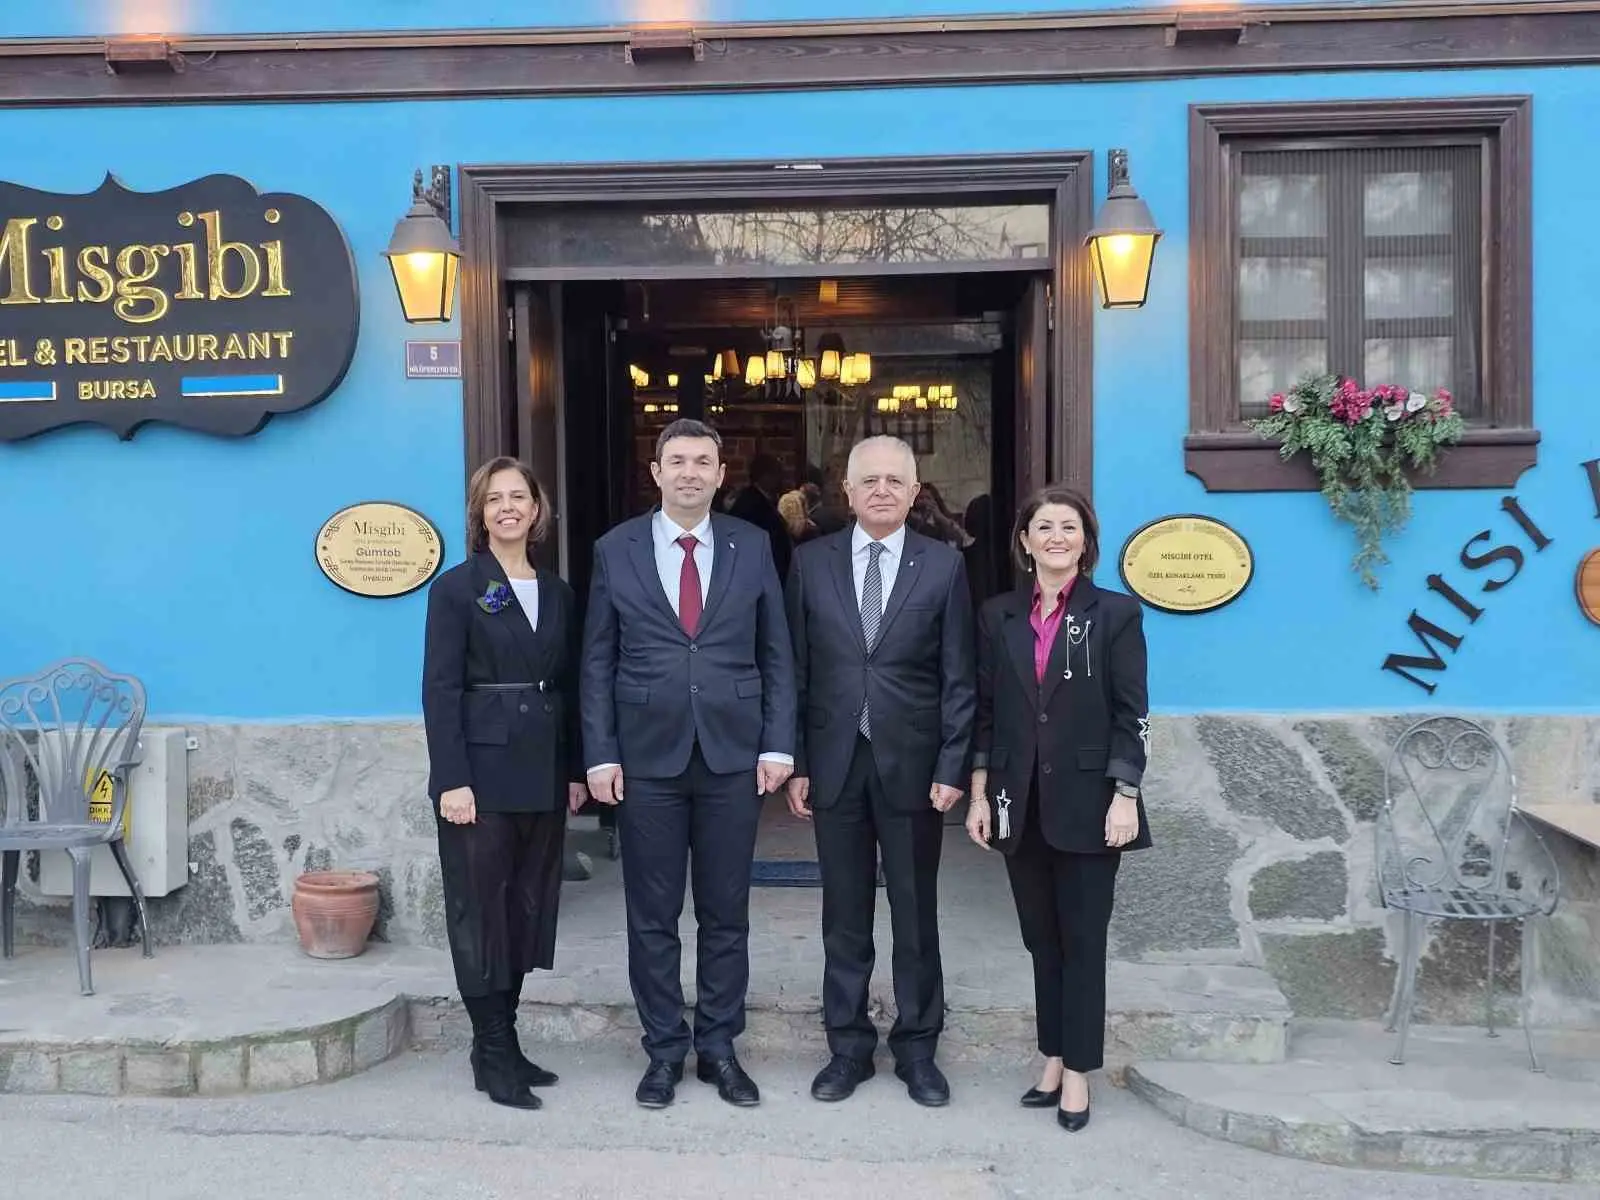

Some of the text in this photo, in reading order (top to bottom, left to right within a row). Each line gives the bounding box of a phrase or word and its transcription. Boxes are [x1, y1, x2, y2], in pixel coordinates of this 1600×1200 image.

[34, 338, 57, 366] &
[64, 331, 293, 365] RESTAURANT
[430, 346, 438, 361] 5
[78, 379, 156, 401] BURSA
[353, 520, 406, 537] Misgibi
[1193, 552, 1213, 561] OTEL
